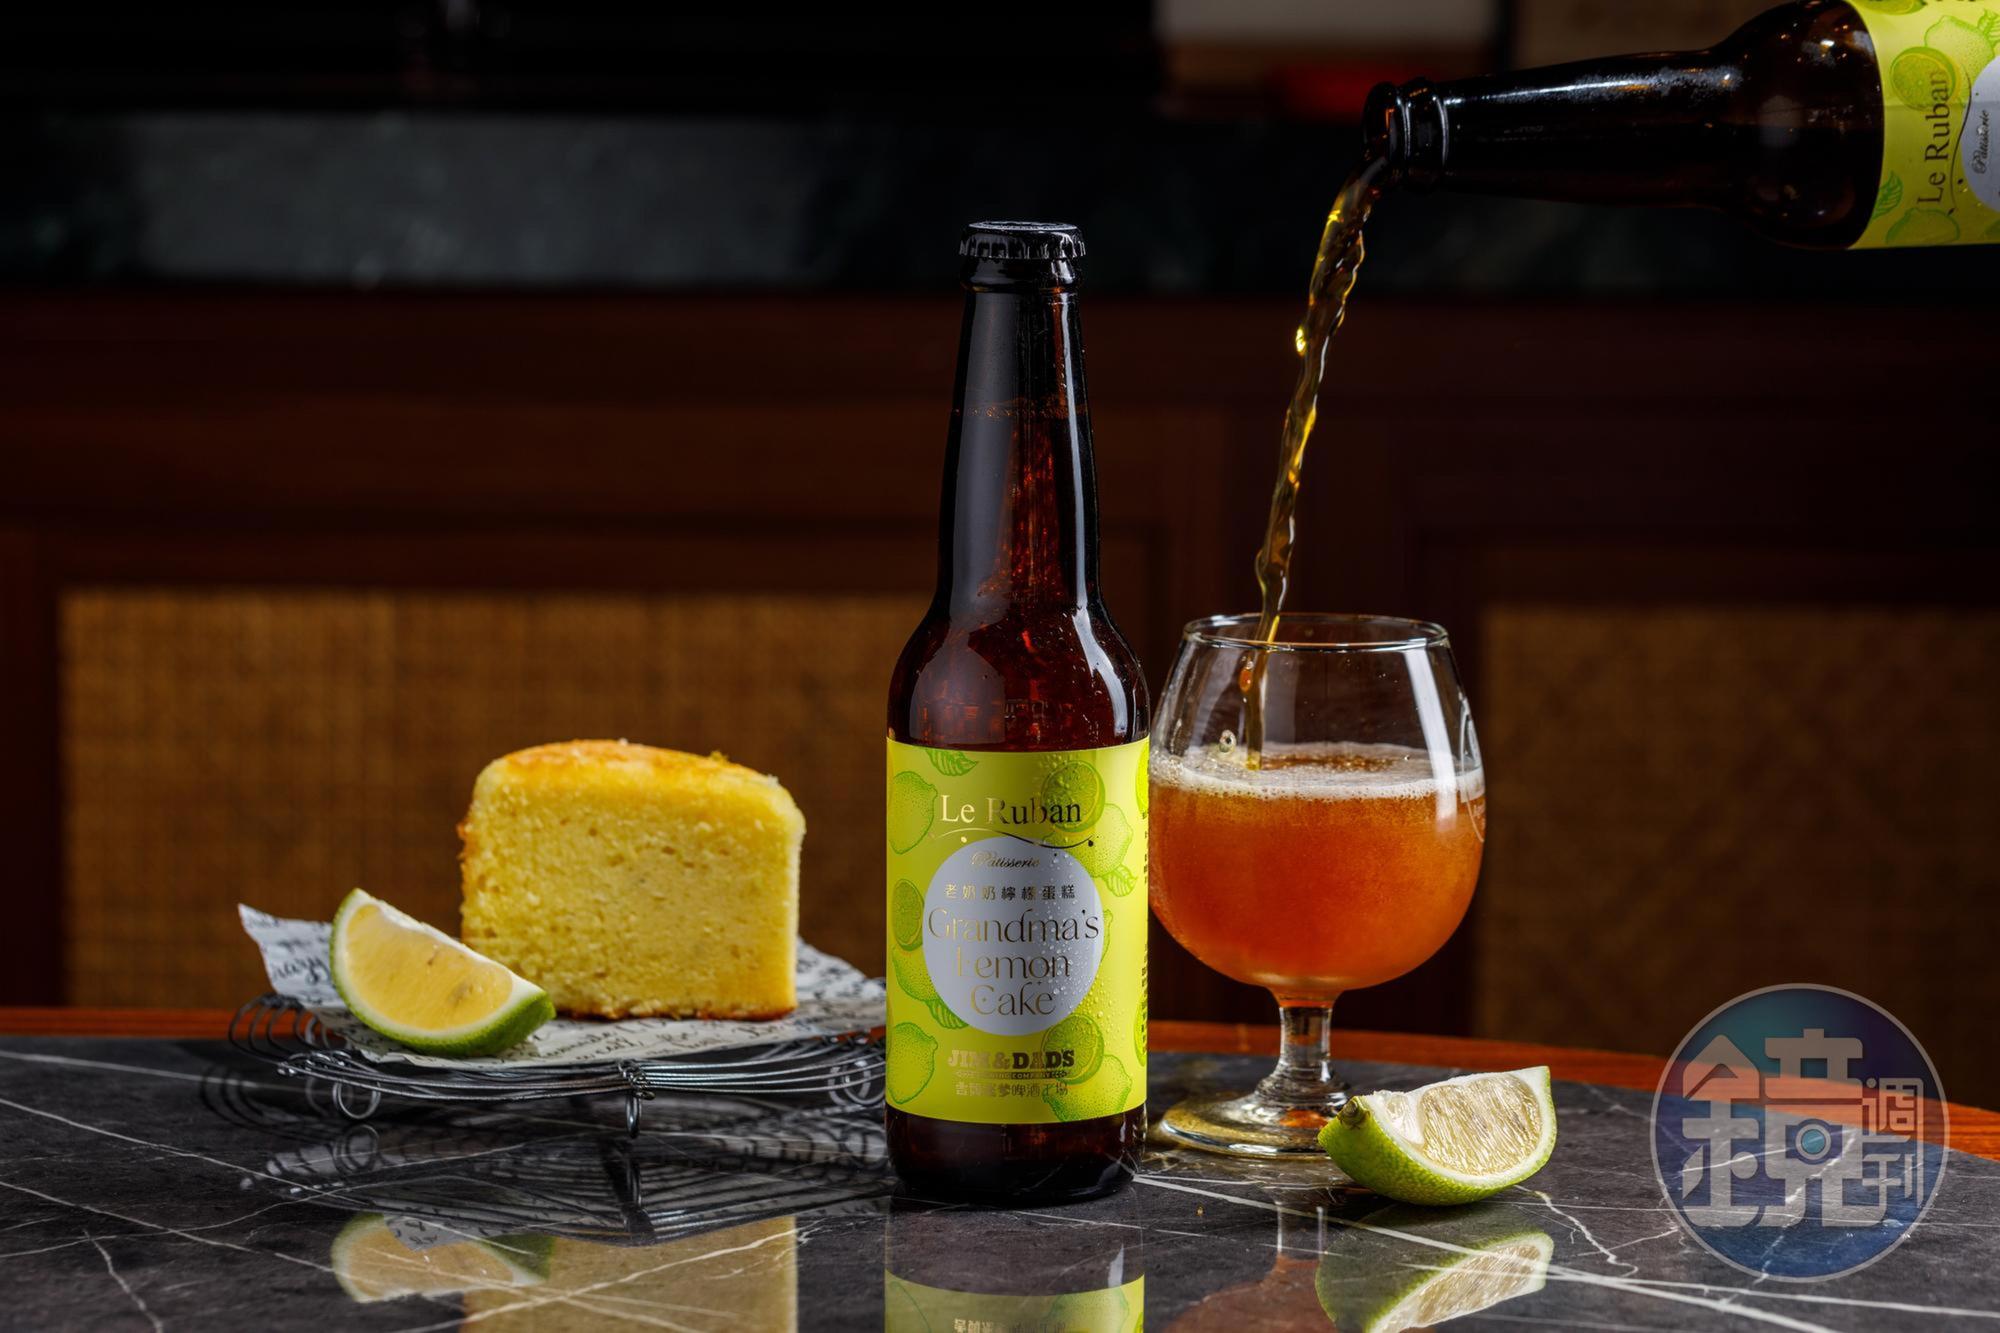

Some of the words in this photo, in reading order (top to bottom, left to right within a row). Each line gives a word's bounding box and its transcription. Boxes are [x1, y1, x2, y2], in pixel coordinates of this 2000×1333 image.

[1924, 70, 1950, 162] Ruban
[1917, 171, 1946, 204] Le
[940, 794, 975, 823] Le
[985, 796, 1082, 825] Ruban
[945, 883, 1076, 901] 老奶奶檸檬蛋糕
[928, 907, 1099, 943] Grandma's
[956, 945, 1071, 979] Lemon
[970, 981, 1057, 1016] Cake
